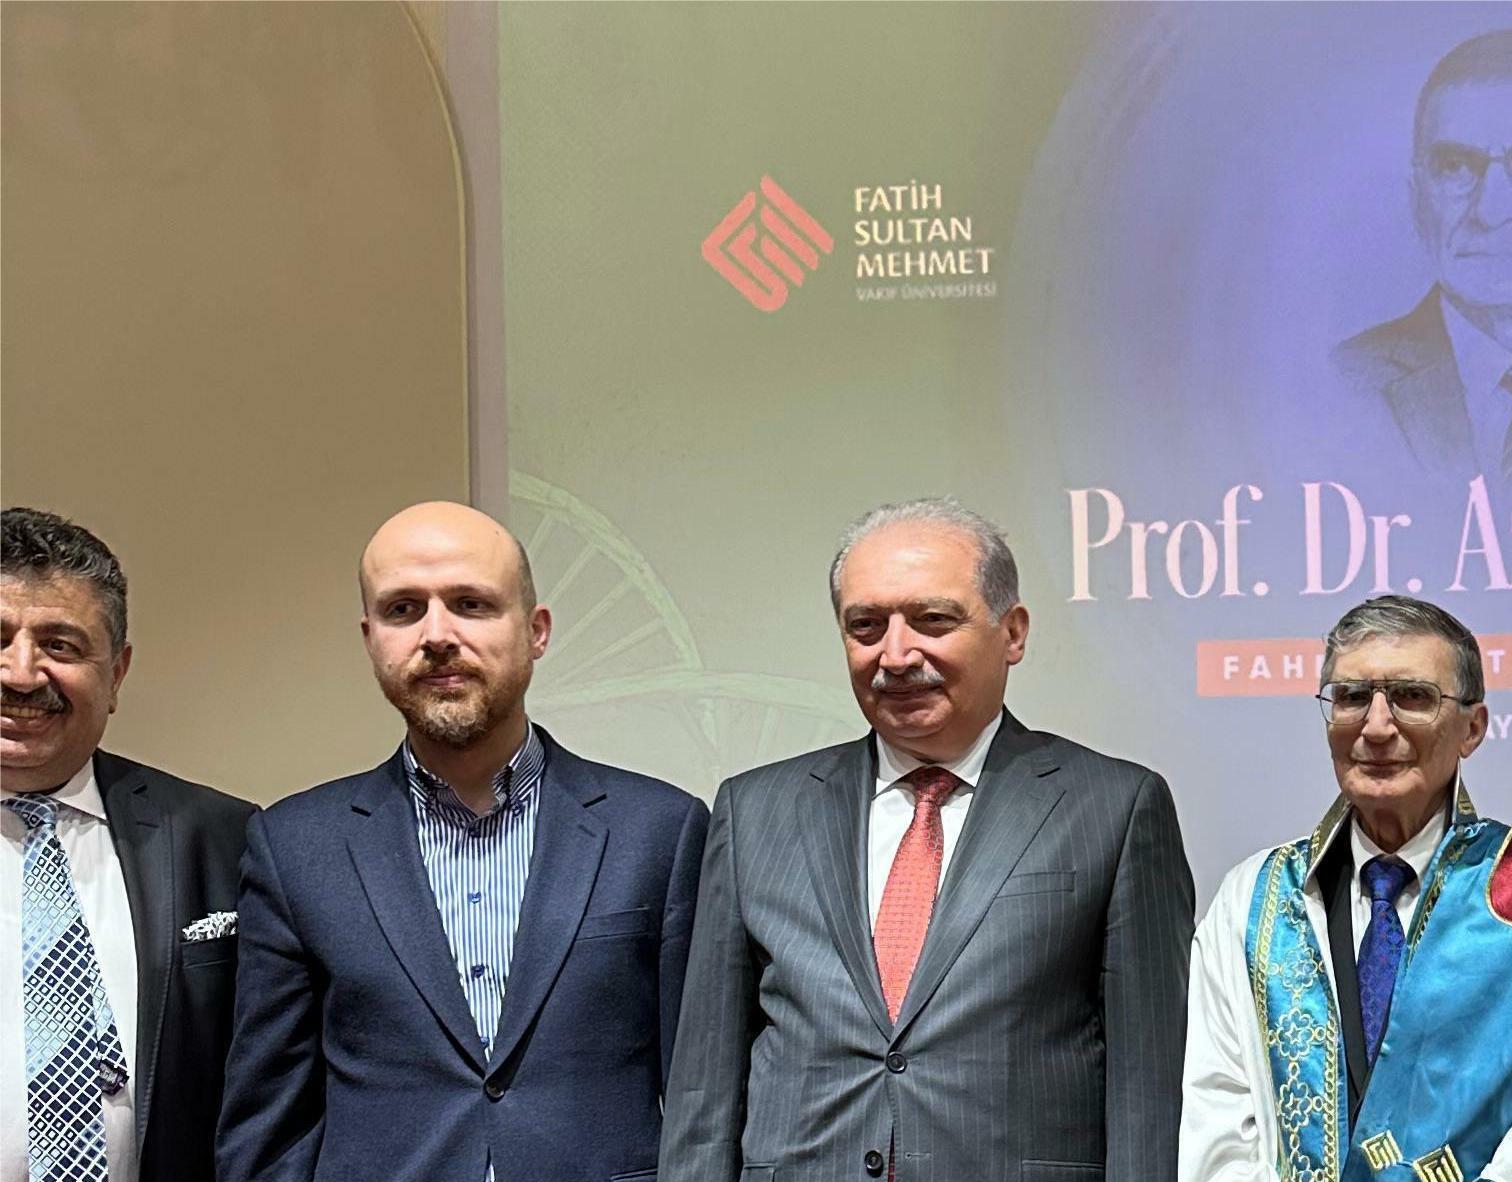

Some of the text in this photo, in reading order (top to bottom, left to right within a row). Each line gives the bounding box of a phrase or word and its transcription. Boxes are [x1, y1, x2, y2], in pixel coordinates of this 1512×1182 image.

[854, 179, 942, 213] FATİH
[854, 216, 972, 246] SULTAN
[856, 248, 996, 278] MEHMET
[1064, 483, 1270, 601] Prof.
[1299, 481, 1423, 594] Dr.
[1223, 654, 1326, 680] FAH
